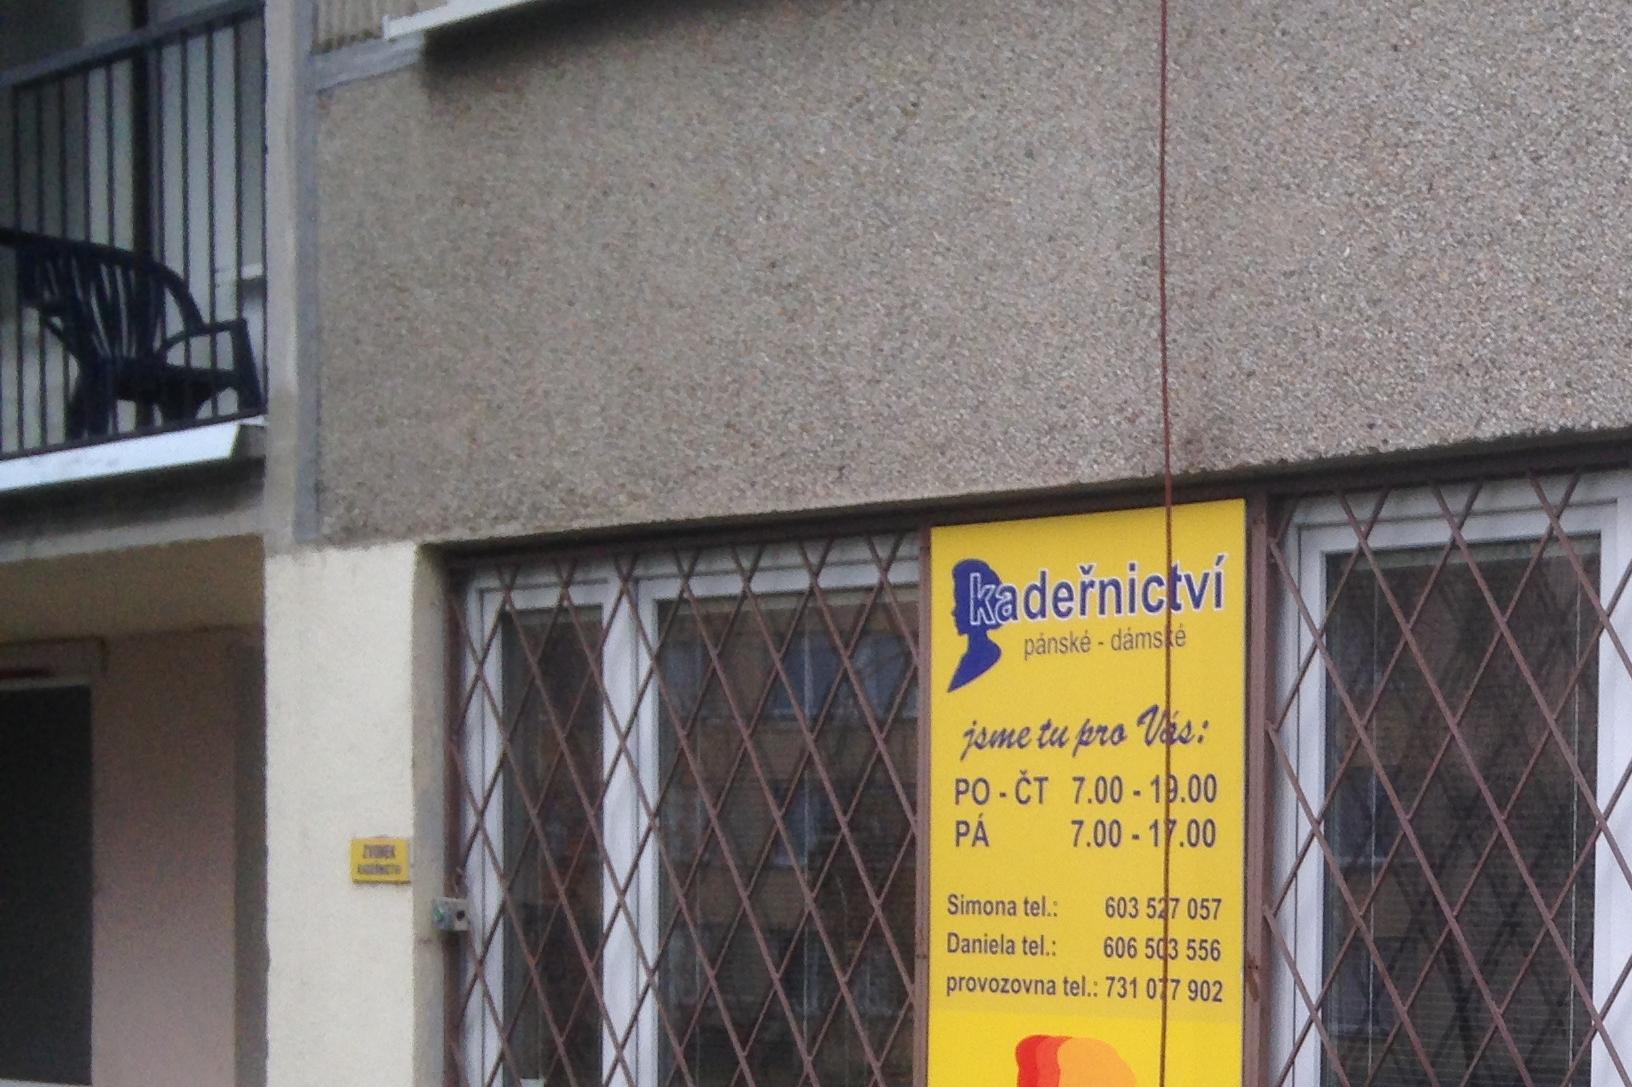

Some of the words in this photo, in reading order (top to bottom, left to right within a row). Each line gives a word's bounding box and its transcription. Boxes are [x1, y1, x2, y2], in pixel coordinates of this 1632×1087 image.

[969, 554, 1227, 625] kadeřnictví
[1024, 629, 1090, 660] pánské
[960, 720, 1031, 761] jsme
[1037, 718, 1070, 749] tu
[1072, 718, 1128, 757] pro
[955, 778, 990, 805] PO
[1015, 770, 1048, 804] ČT
[1072, 775, 1123, 805] 7.00
[1150, 774, 1217, 804] 19.00
[955, 813, 990, 847] PÁ
[1071, 819, 1122, 848] 7.00
[1149, 819, 1216, 848] 17.00
[947, 894, 1017, 917] Simona
[1023, 895, 1058, 917] tel.:
[1105, 896, 1139, 919] 603
[1146, 897, 1181, 919] 527
[1187, 898, 1222, 920] 057
[947, 932, 1016, 956] Daniela
[1022, 935, 1057, 957] tel.:
[1104, 936, 1138, 959] 606
[1145, 937, 1179, 960] 503
[1186, 938, 1221, 961] 556
[946, 974, 1056, 997] provozovna
[1063, 975, 1098, 998] tel.:
[1105, 976, 1137, 998] 731
[1187, 979, 1223, 1002] 902
